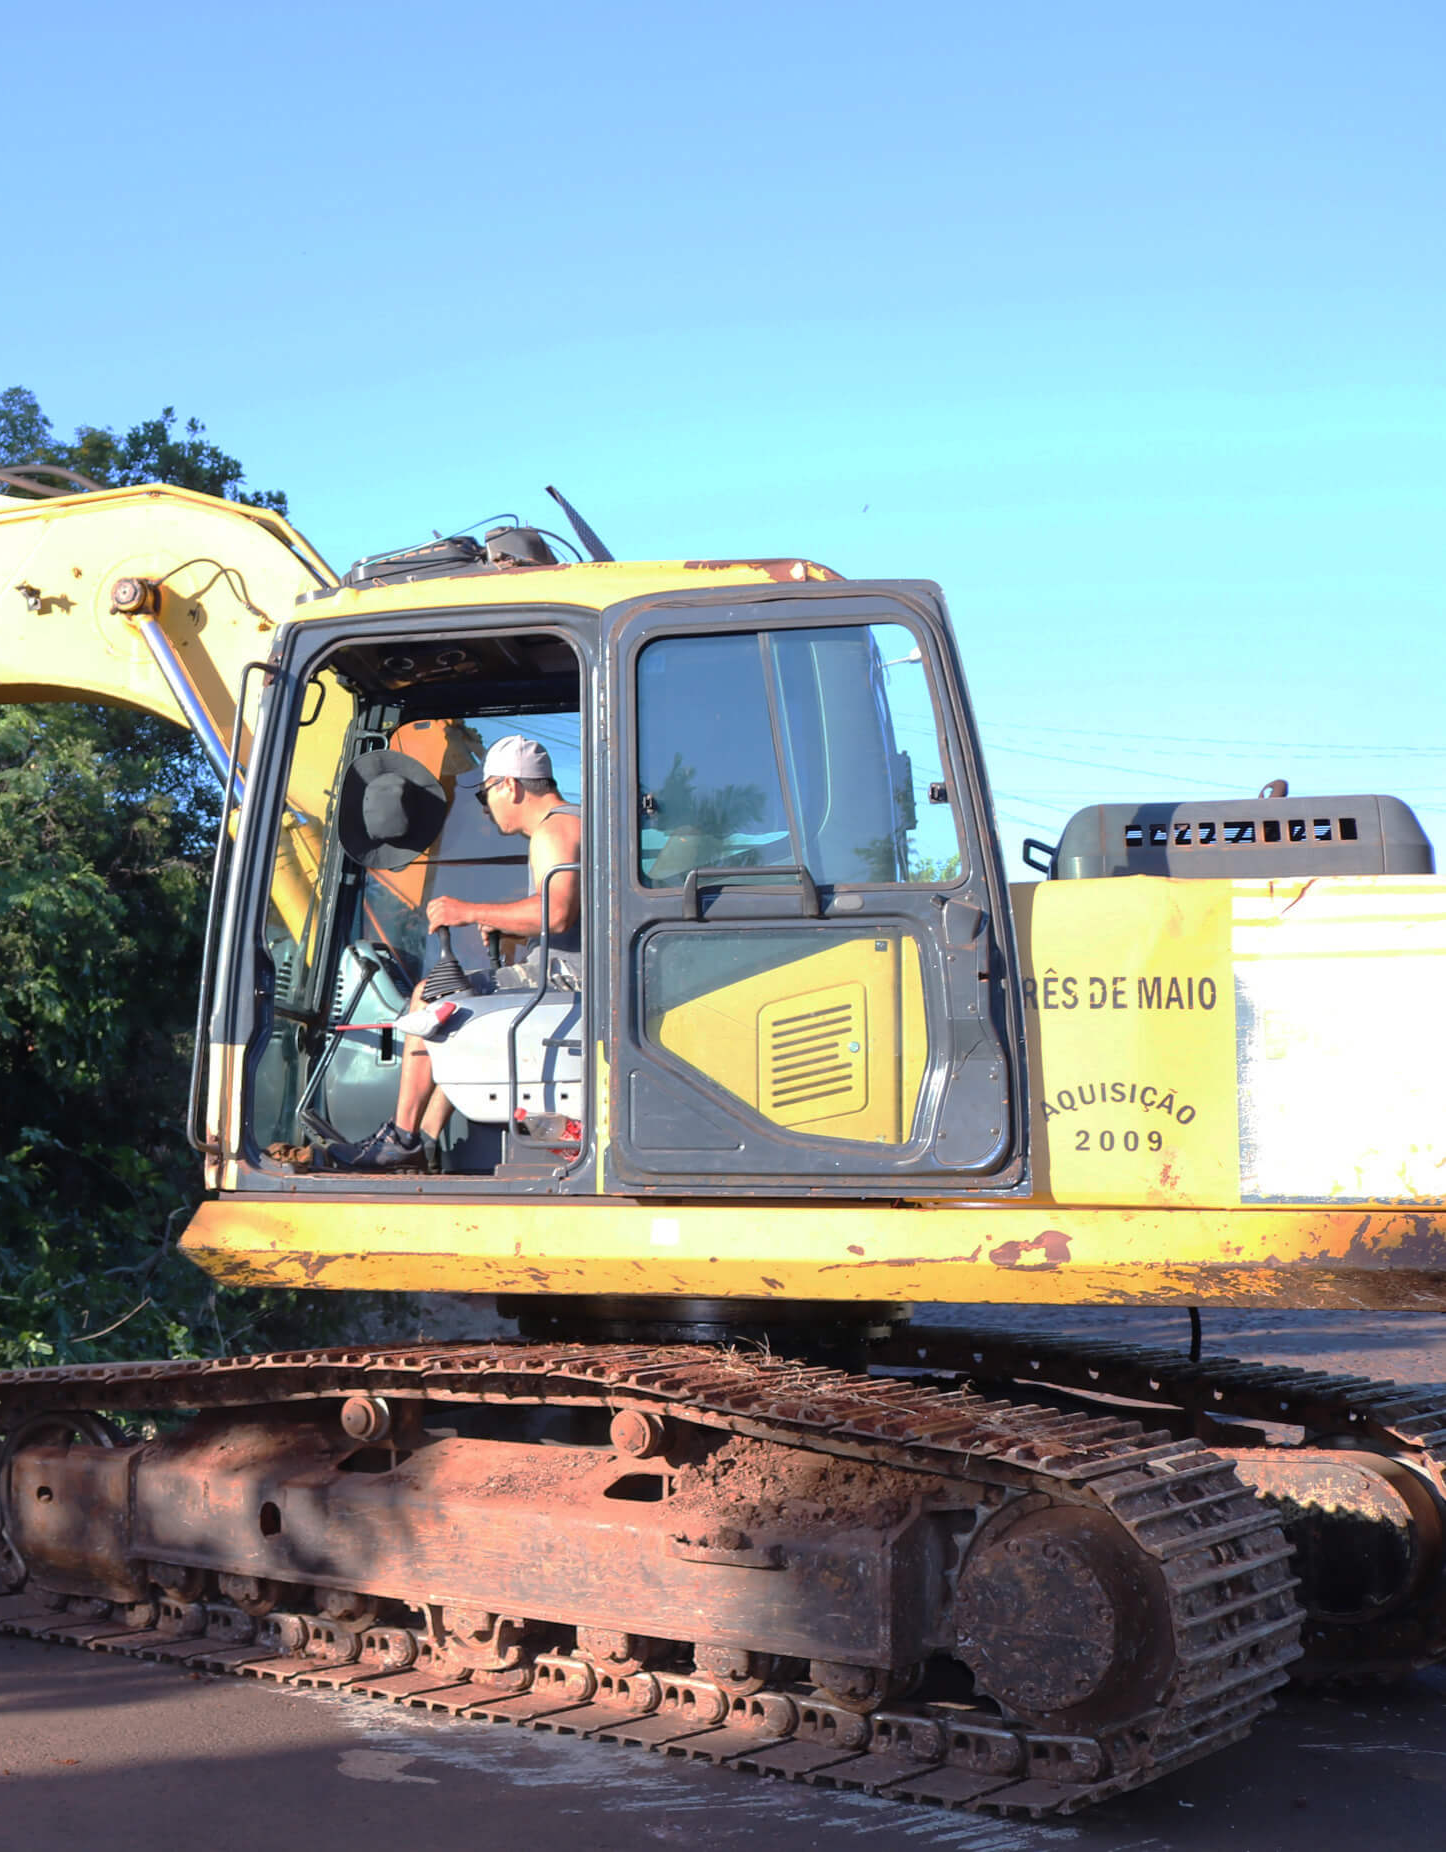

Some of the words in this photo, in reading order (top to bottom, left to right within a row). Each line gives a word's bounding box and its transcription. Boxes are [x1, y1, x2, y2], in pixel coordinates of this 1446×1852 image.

[1022, 967, 1079, 1010] RÊS
[1089, 976, 1128, 1010] DE
[1137, 976, 1217, 1011] MAIO
[1040, 1082, 1196, 1125] AQUISIÇÃO
[1075, 1130, 1163, 1152] 2009
